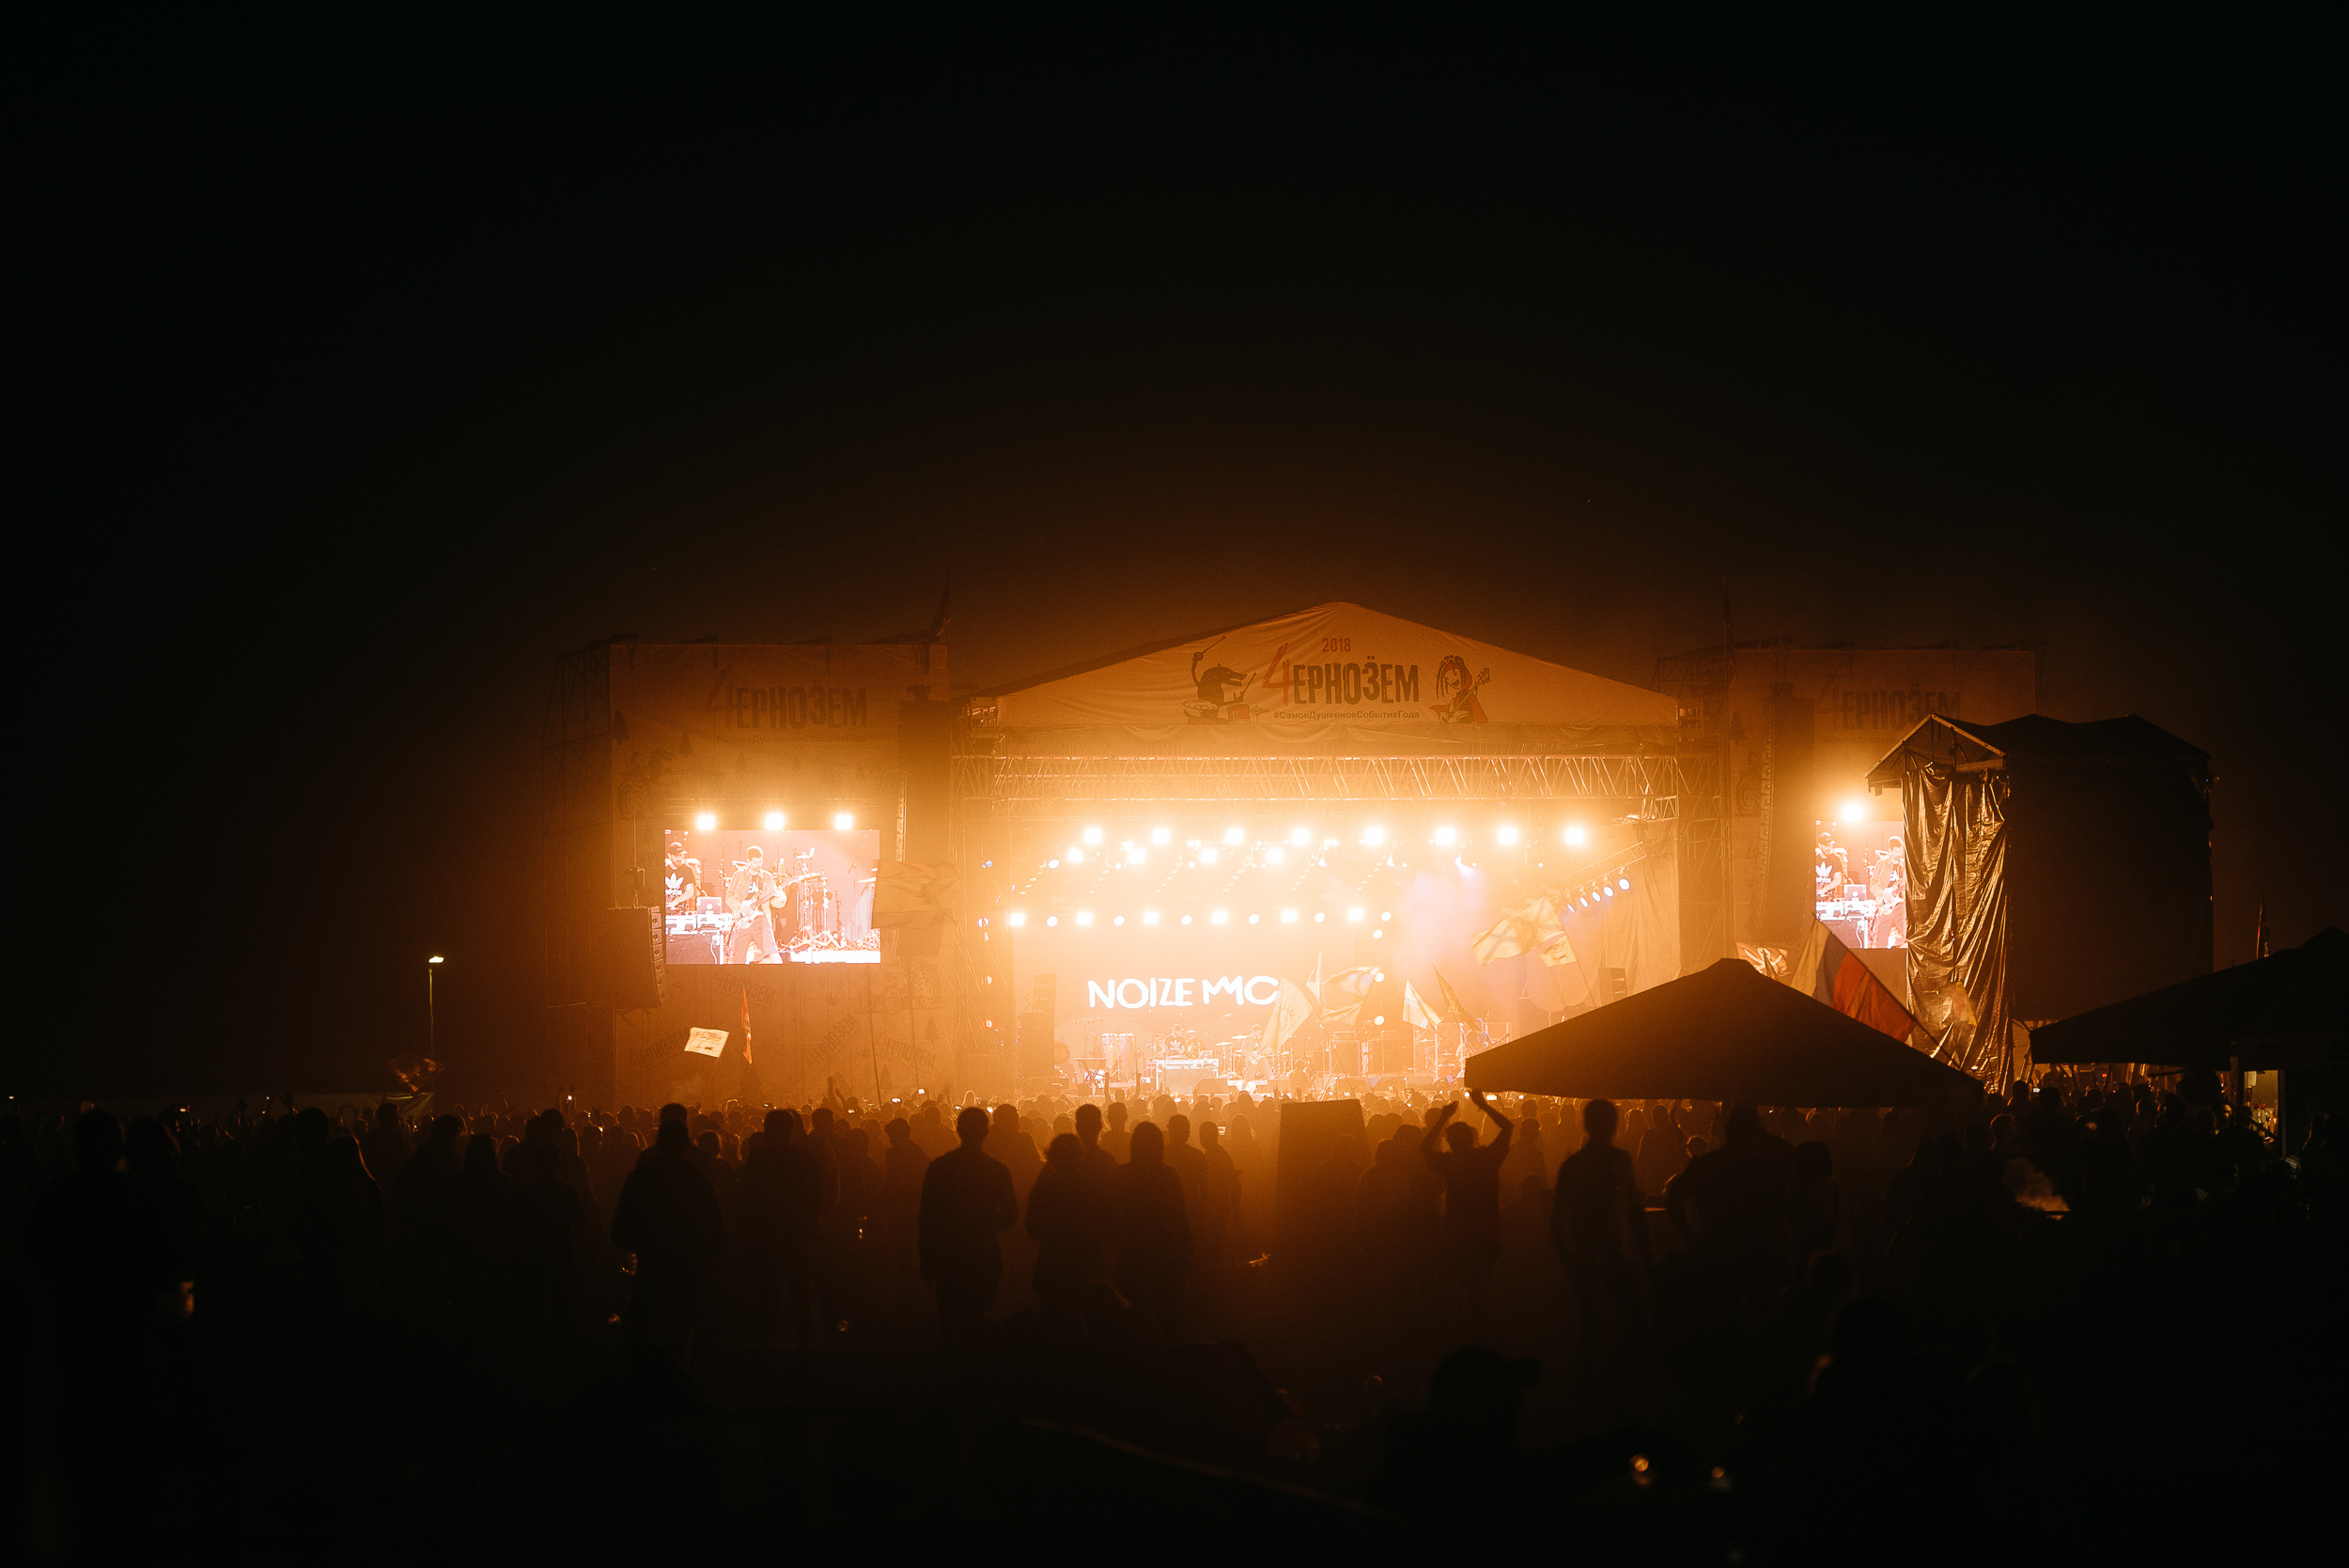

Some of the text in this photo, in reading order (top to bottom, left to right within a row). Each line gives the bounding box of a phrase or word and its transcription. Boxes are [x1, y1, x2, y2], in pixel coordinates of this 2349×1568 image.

[1322, 638, 1351, 653] 2018
[1273, 710, 1420, 722] #СамоеДушевноеСобытиеГода
[1088, 975, 1279, 1009] NOIZE MC
